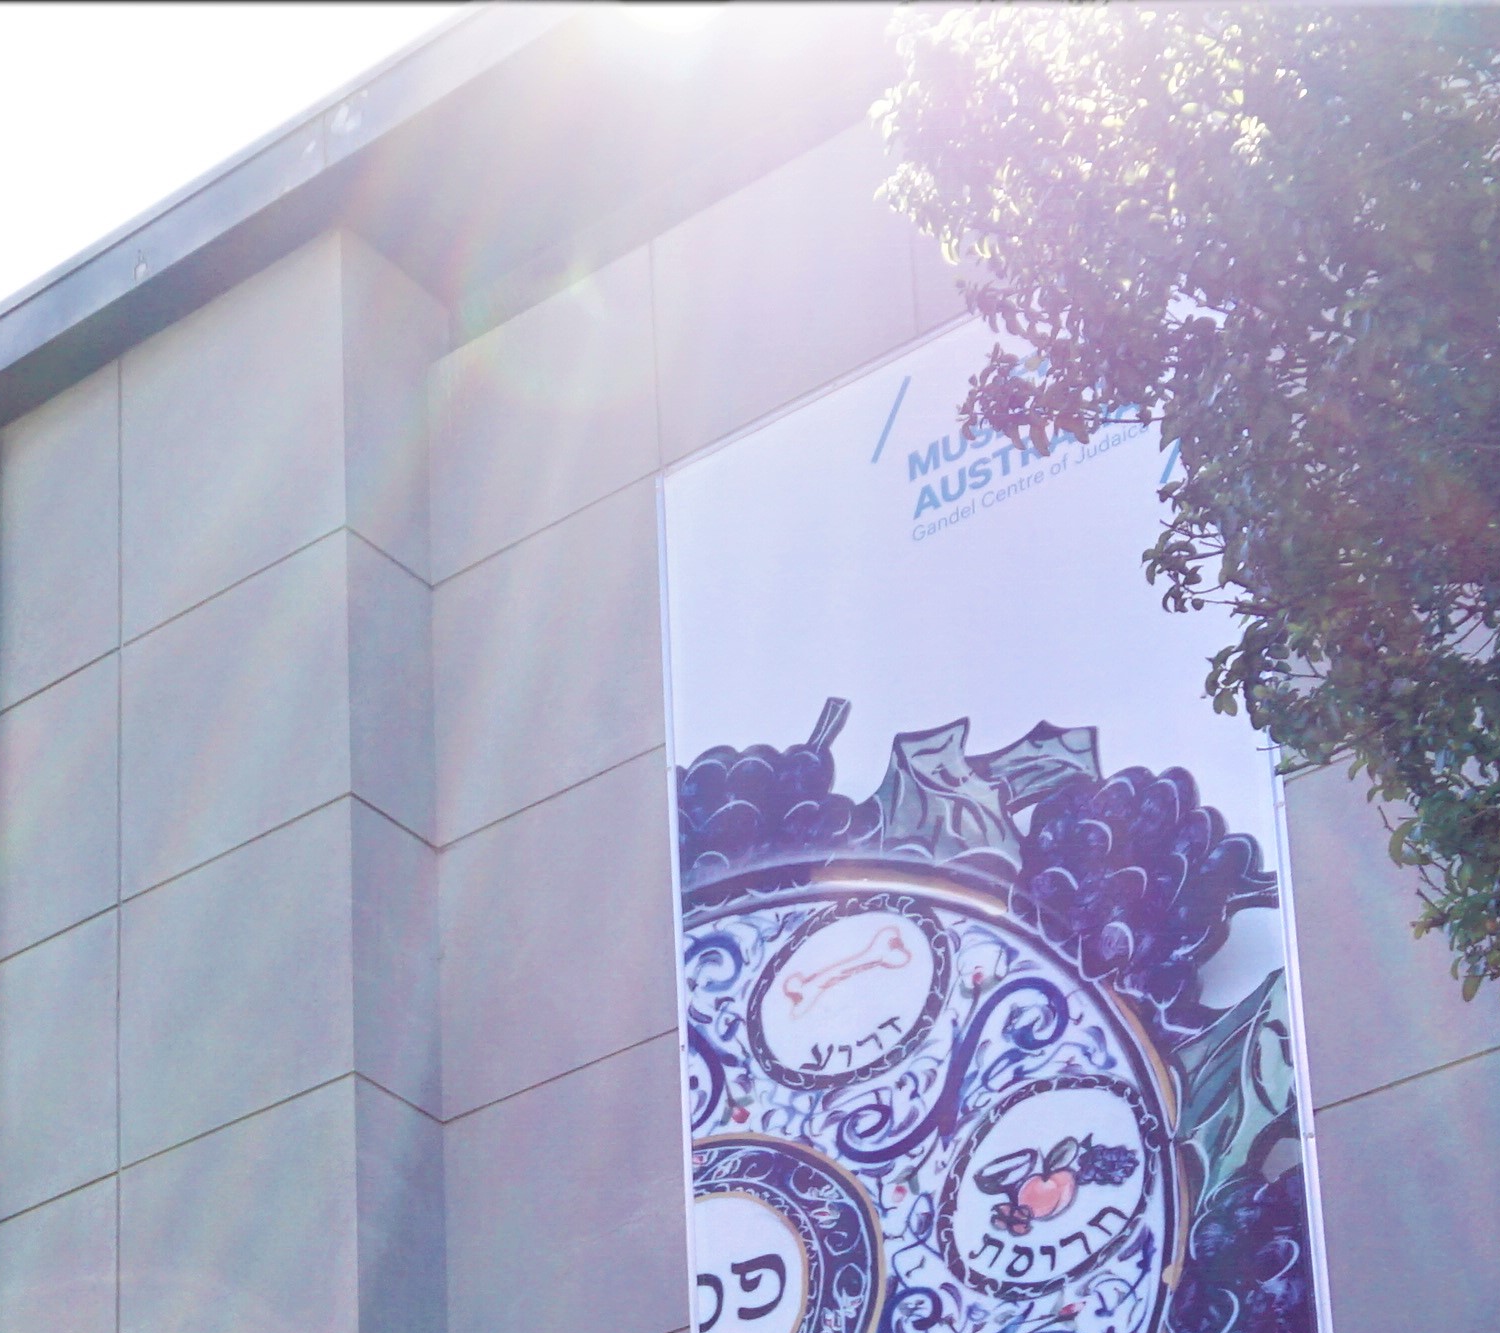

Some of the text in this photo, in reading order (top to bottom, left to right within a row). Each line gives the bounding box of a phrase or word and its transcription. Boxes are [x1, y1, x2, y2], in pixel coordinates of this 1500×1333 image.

[912, 424, 1149, 542] Gandel Centre of Judaica
[968, 1206, 1130, 1278] חרוסת
